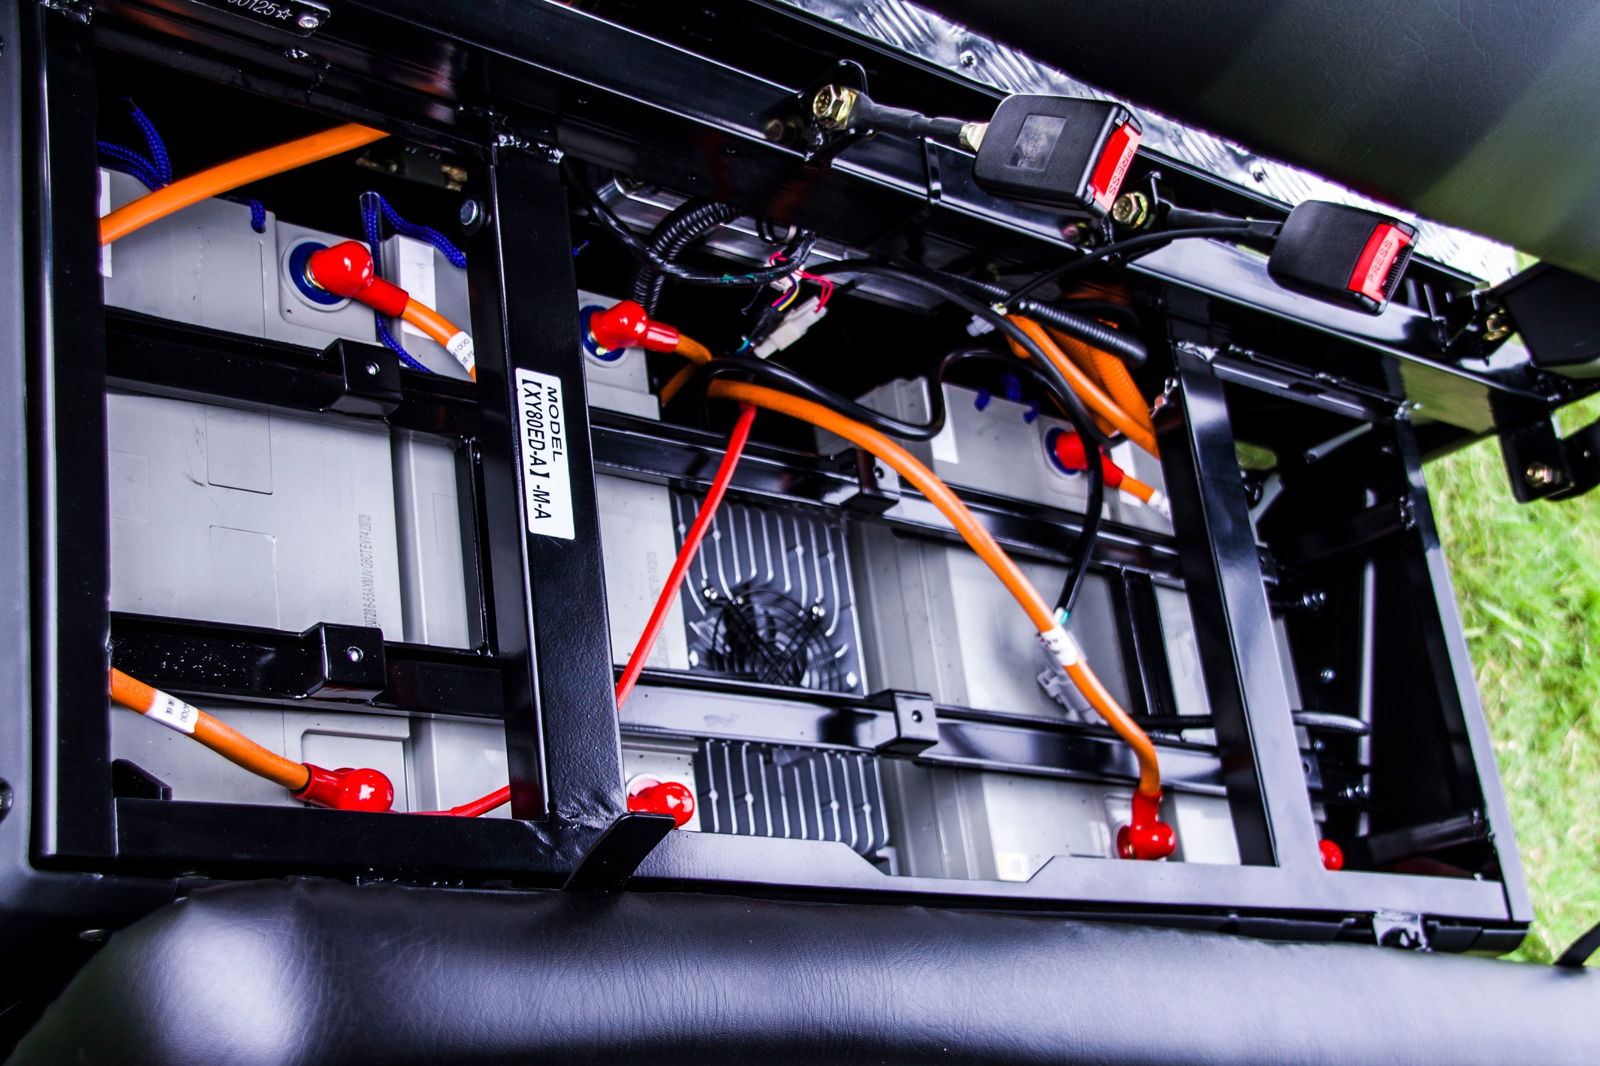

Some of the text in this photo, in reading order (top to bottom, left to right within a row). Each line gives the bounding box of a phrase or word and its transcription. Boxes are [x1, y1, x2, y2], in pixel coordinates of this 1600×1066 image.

[228, 0, 280, 16] 0125
[1107, 147, 1134, 196] PRESS
[1367, 239, 1394, 284] PRESS
[547, 386, 563, 462] MODEL
